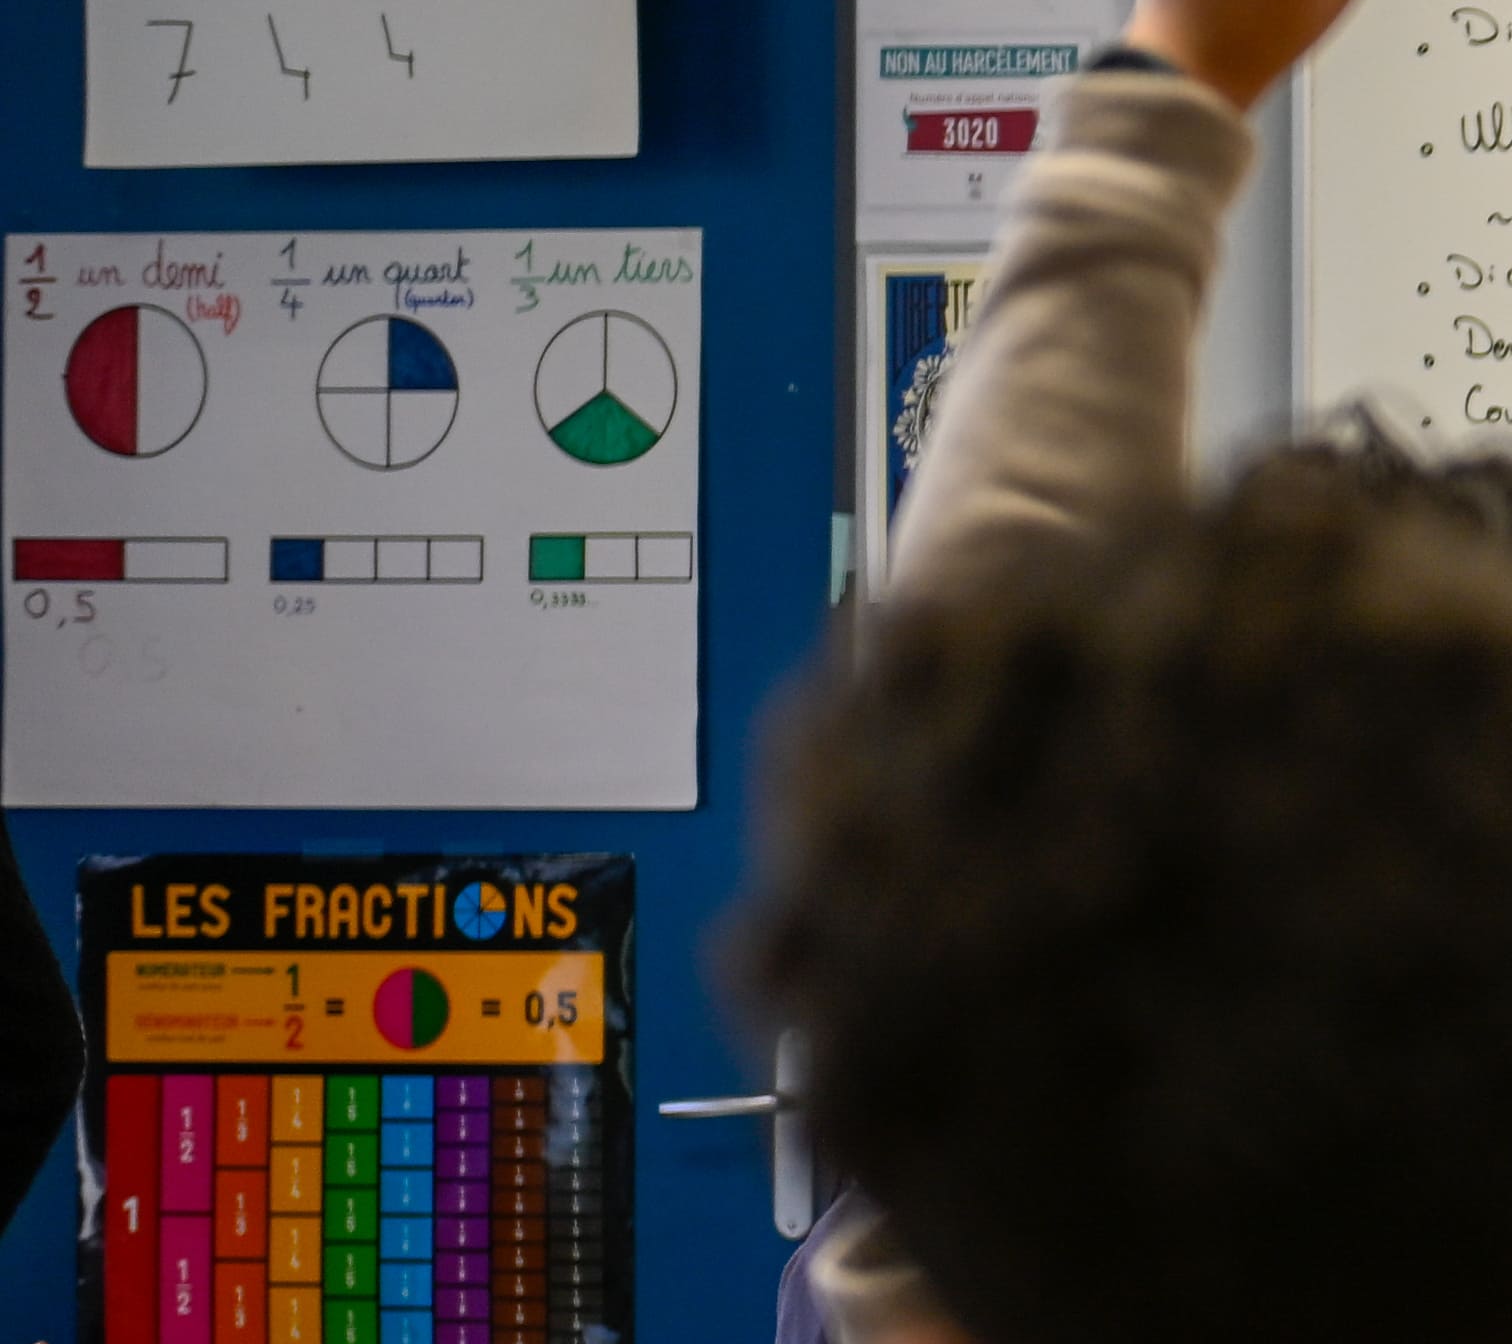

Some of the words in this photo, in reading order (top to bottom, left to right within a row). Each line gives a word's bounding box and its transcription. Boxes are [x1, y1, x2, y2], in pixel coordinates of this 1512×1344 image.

[146, 19, 197, 105] 7
[266, 13, 312, 101] 4
[380, 13, 415, 80] 4
[885, 51, 919, 73] NON
[925, 50, 947, 73] AU
[943, 117, 998, 148] 3020
[26, 245, 47, 275] 1
[76, 262, 125, 287] un
[141, 243, 227, 290] demi
[279, 238, 296, 270] 1
[322, 263, 373, 287] un
[383, 248, 472, 311] quart
[511, 239, 536, 272] 1
[546, 259, 604, 285] un
[615, 243, 695, 284] tiers
[25, 290, 55, 321] 2
[183, 294, 241, 338] (half)
[278, 291, 306, 320] 4
[513, 289, 543, 316] 3
[23, 587, 97, 629] 0,5
[132, 884, 230, 938] LES
[524, 991, 578, 1032] 0,5
[122, 1194, 139, 1233] 1
